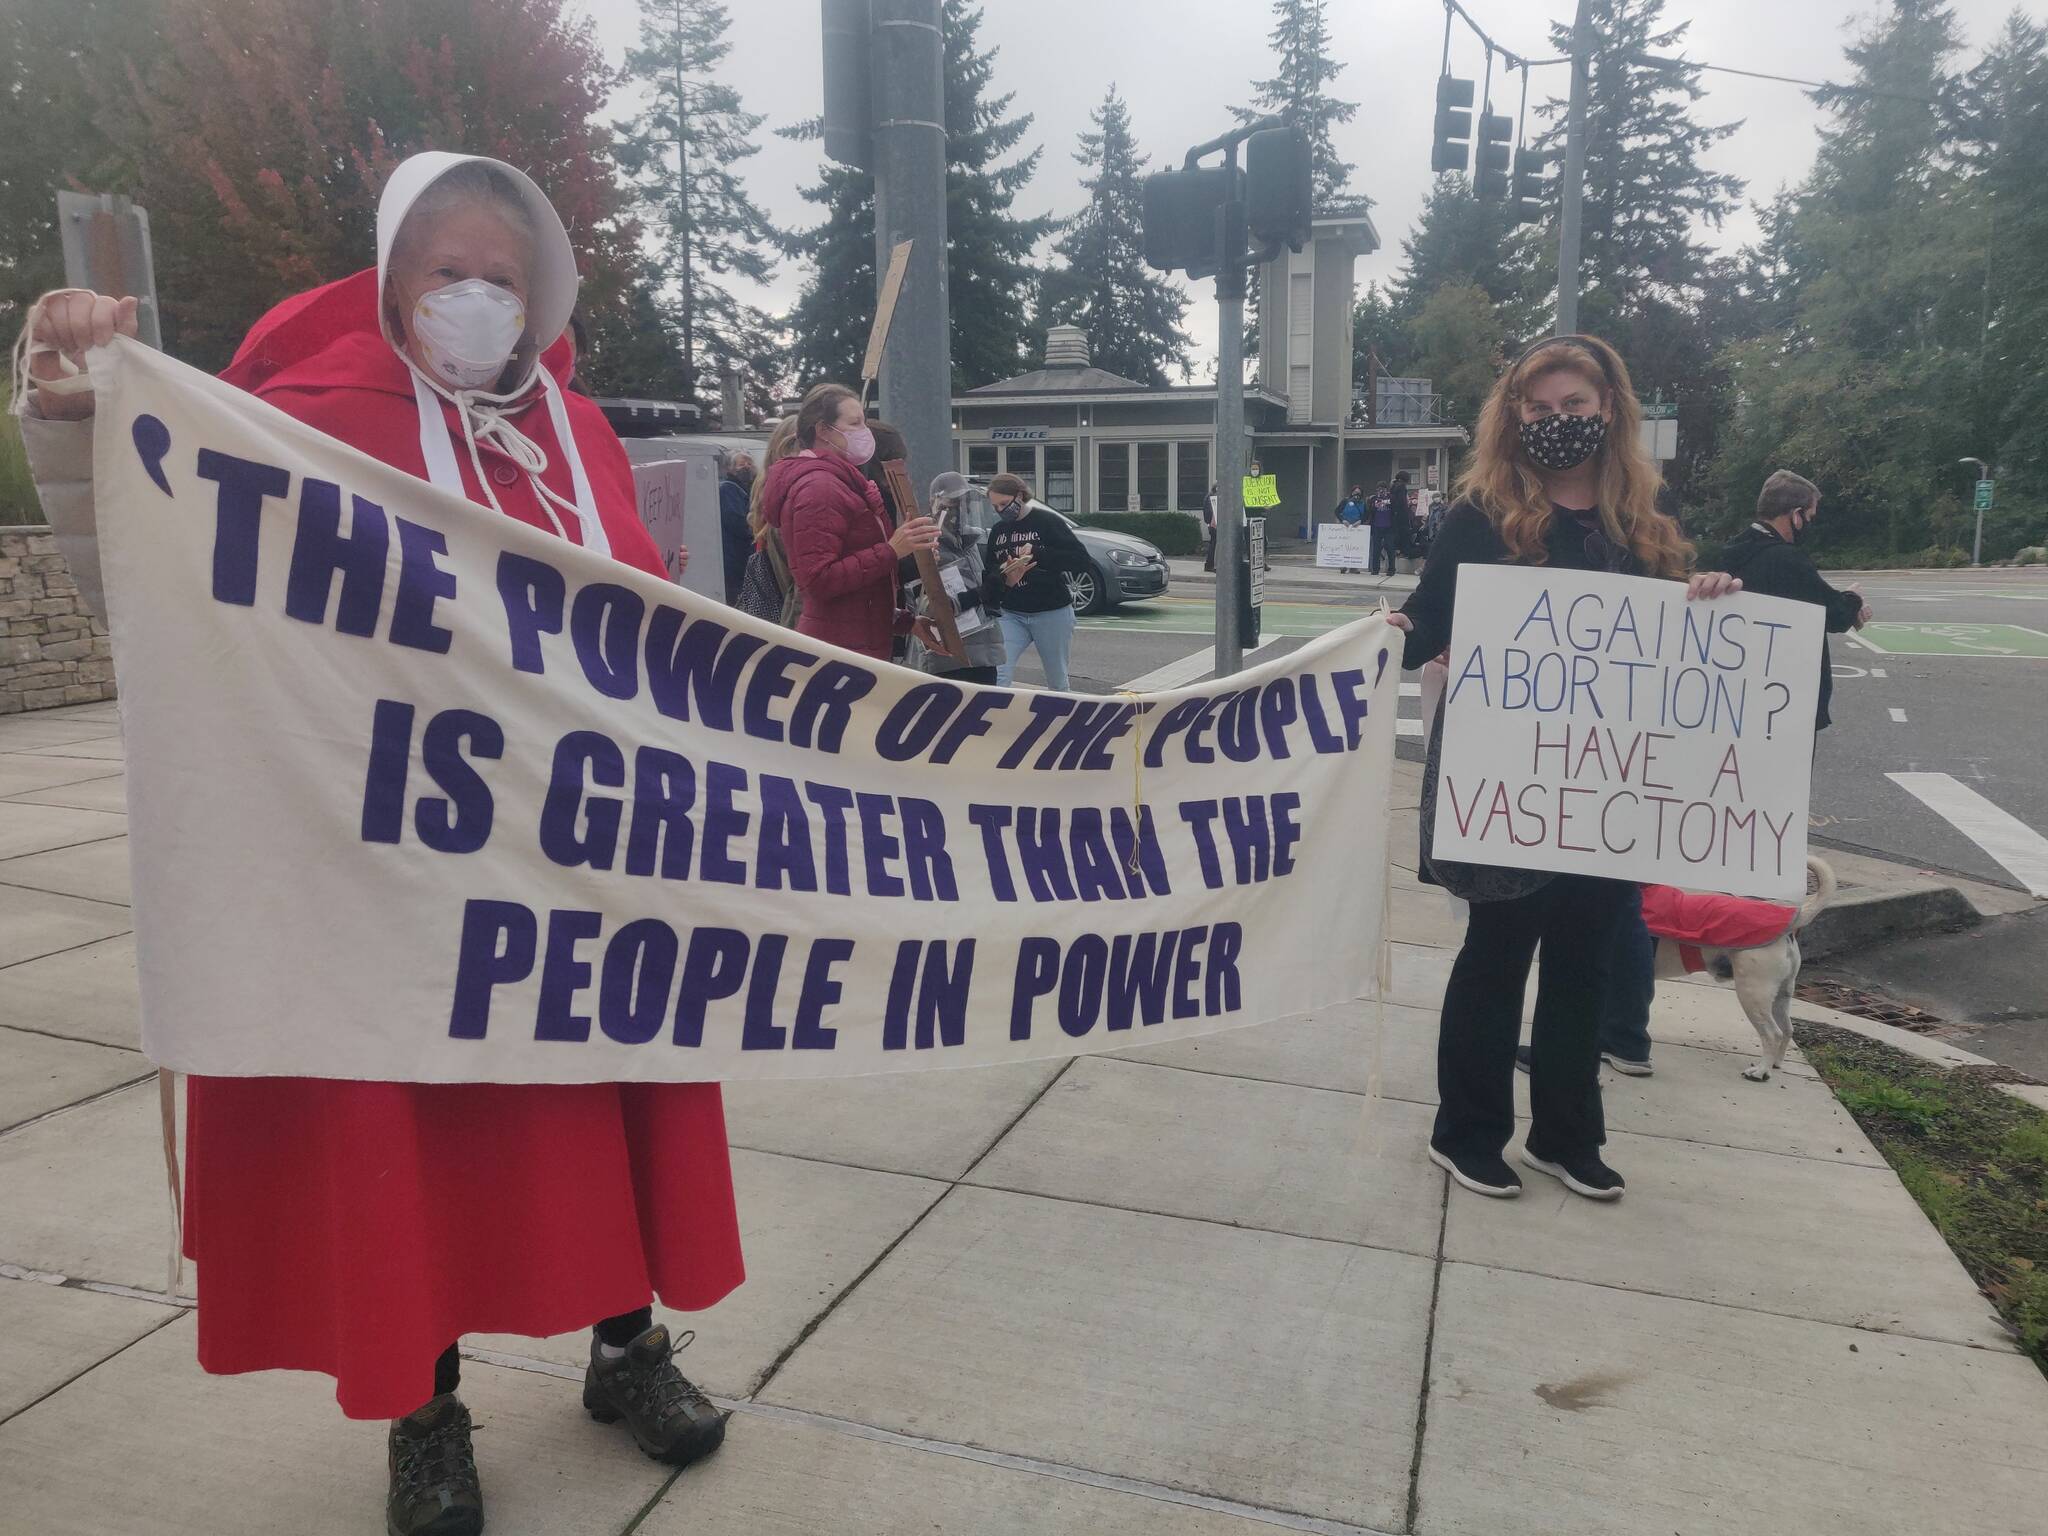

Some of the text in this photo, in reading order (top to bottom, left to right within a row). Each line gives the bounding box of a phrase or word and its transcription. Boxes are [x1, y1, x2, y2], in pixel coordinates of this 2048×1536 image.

[991, 431, 1047, 439] POLICE
[497, 550, 877, 754] POWER
[874, 682, 1015, 764] OF
[997, 694, 1153, 771] THE
[1514, 589, 1792, 677] AGAINST
[1449, 645, 1790, 740] ABORTION?
[361, 698, 1301, 902] IS GREATER THAN THE
[1534, 721, 1744, 802] HAVE A
[1446, 775, 1793, 876] VASECTOMY
[448, 898, 1243, 1051] PEOPLE IN POWER
